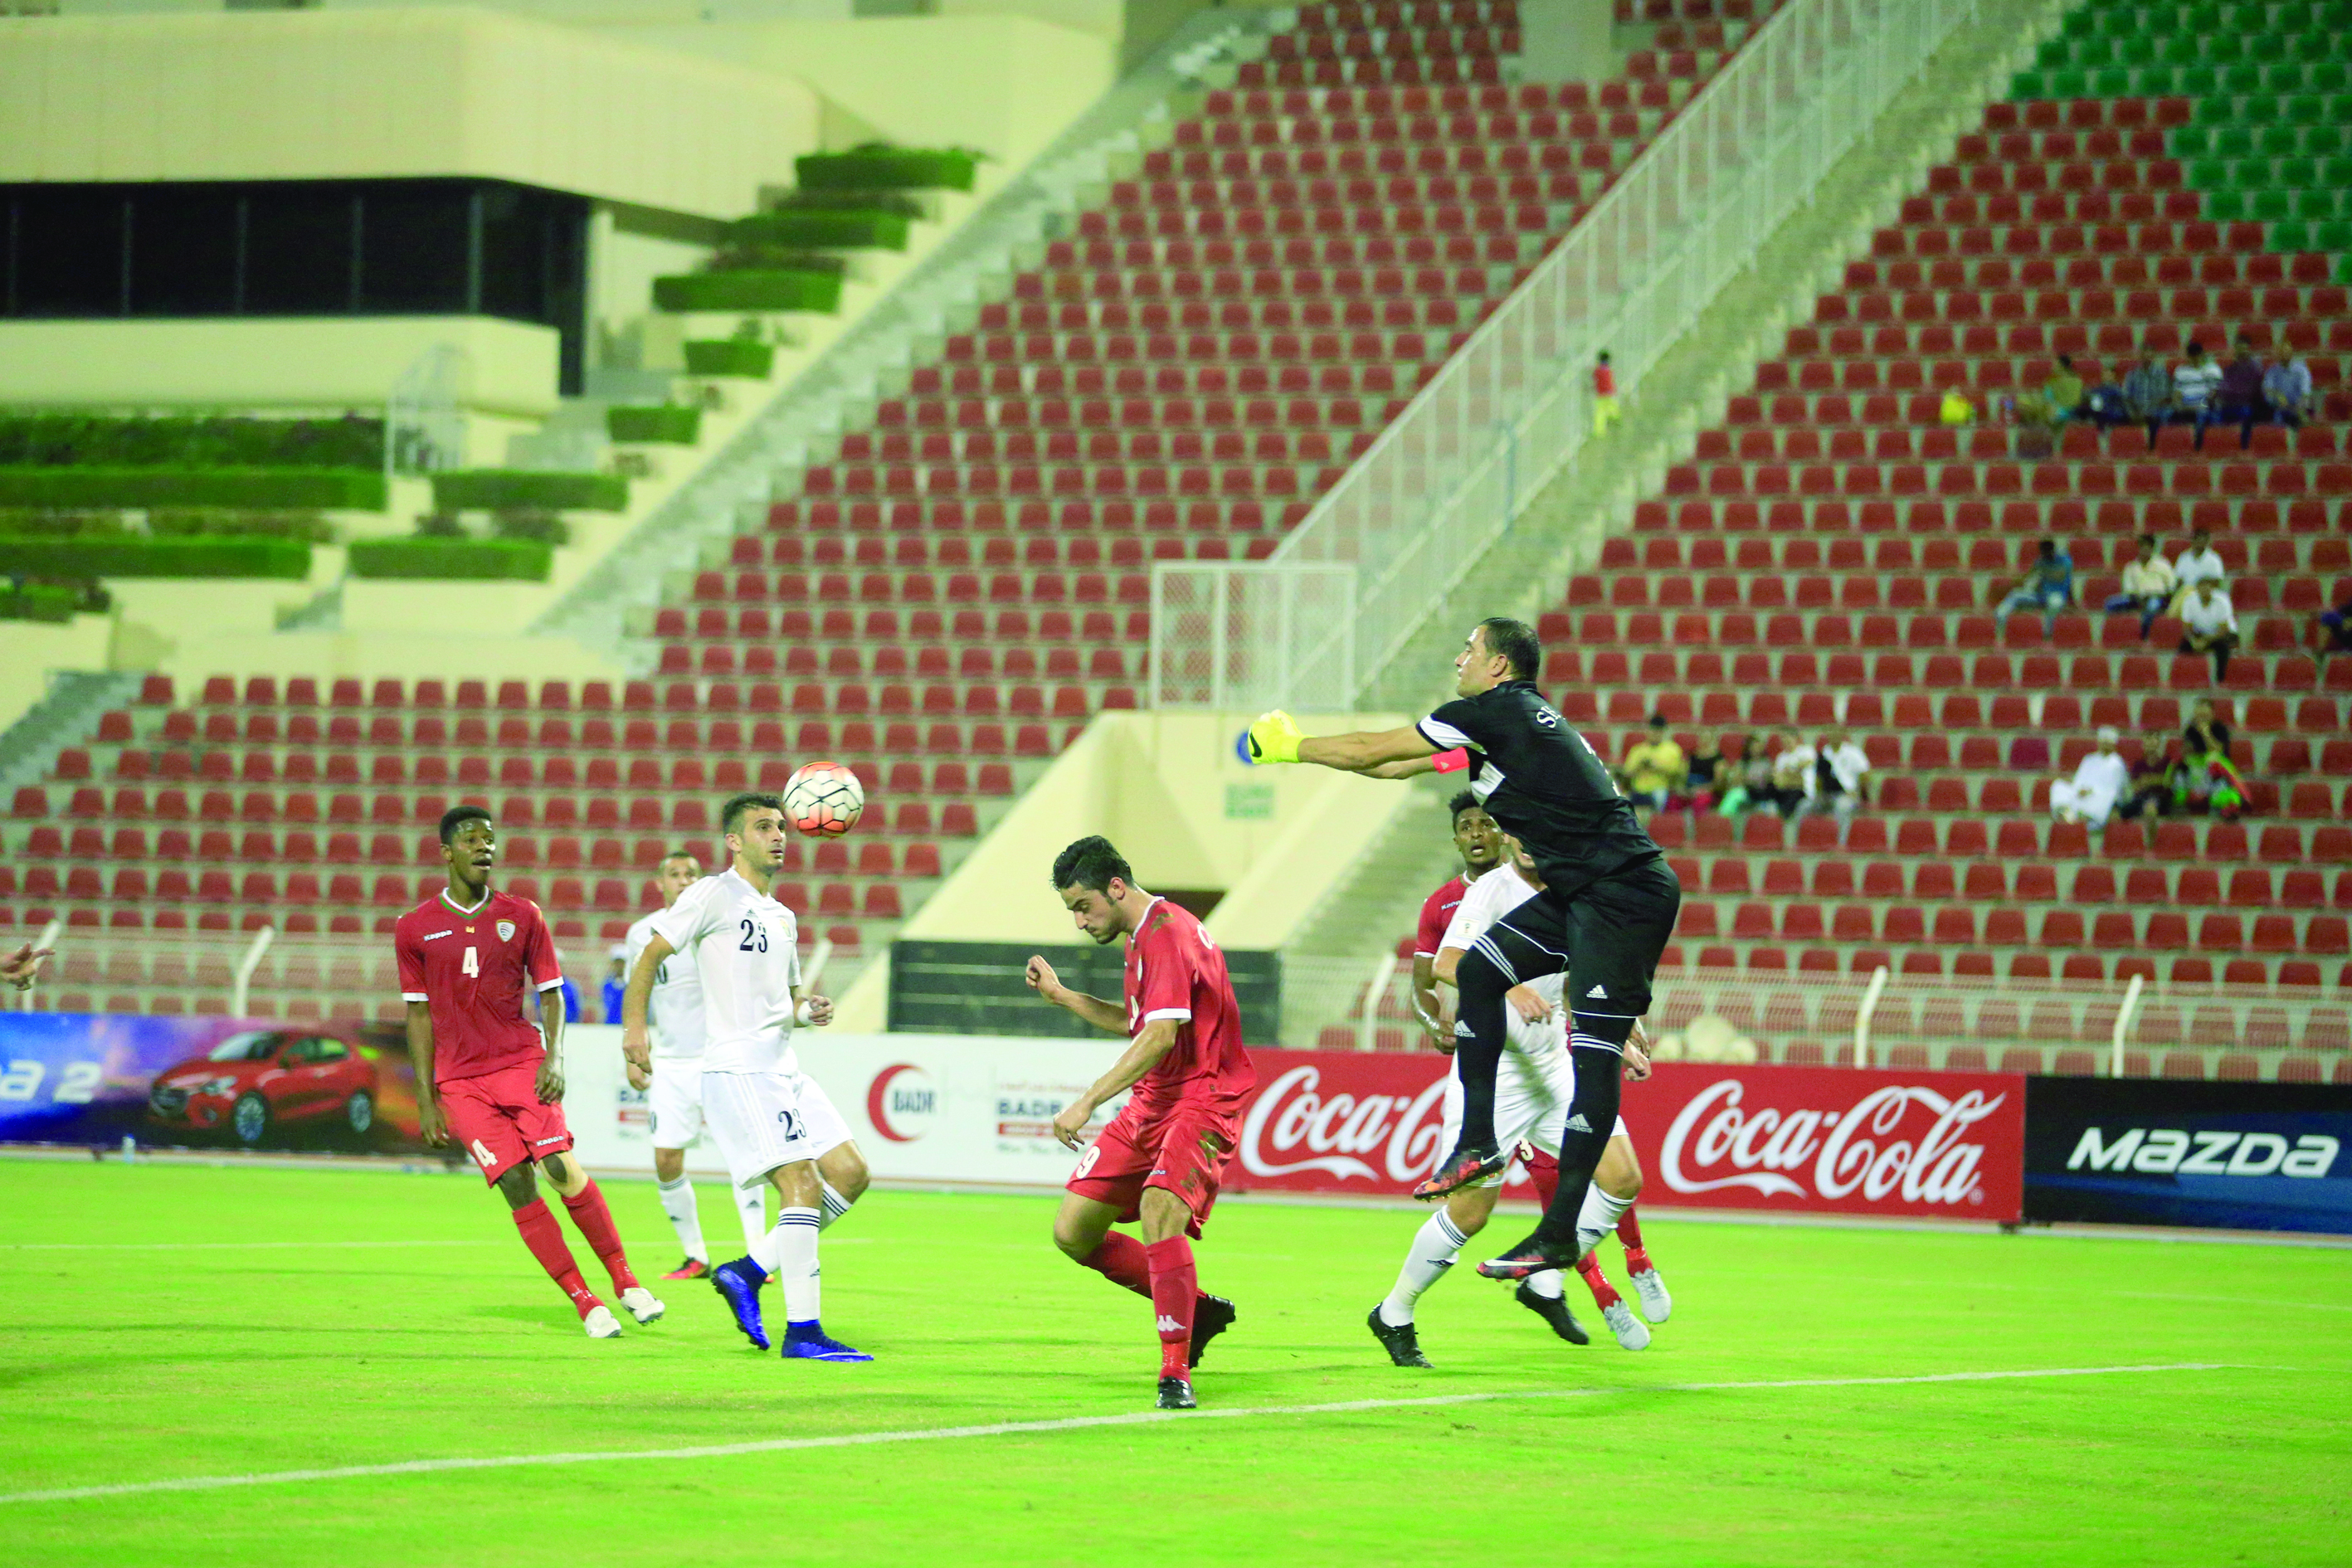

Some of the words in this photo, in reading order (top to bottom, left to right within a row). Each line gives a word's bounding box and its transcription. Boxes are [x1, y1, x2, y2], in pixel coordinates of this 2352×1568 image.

[424, 929, 453, 941] Kappa
[740, 919, 767, 952] 23
[462, 946, 480, 978] 4
[0, 1059, 45, 1100] a
[52, 1062, 101, 1103] 2
[536, 1135, 564, 1147] Kappa
[778, 1108, 806, 1142] 23
[1239, 1064, 1533, 1186] Coca-C
[472, 1138, 498, 1167] 4
[1659, 1079, 2006, 1205] Coca-Cola
[1075, 1145, 1101, 1179] 9
